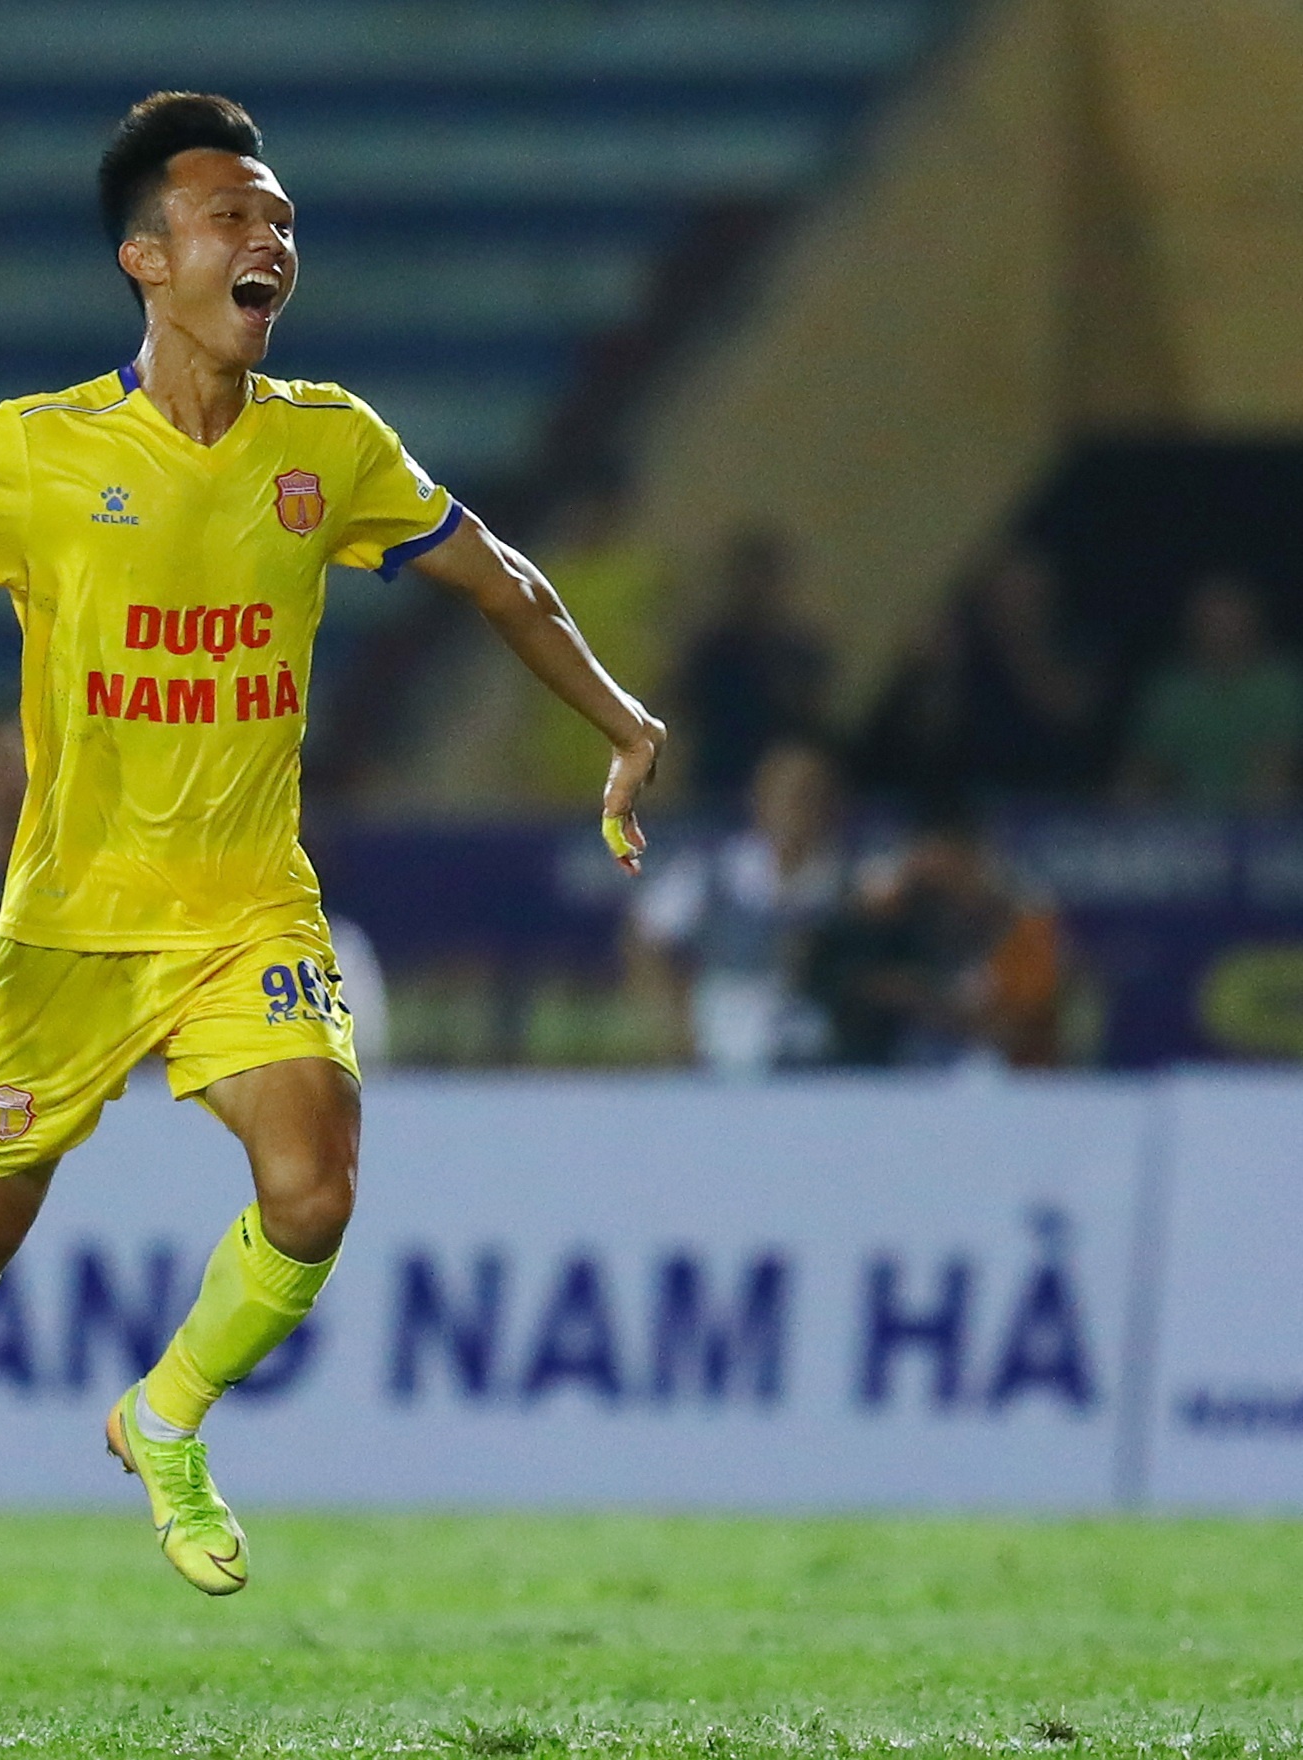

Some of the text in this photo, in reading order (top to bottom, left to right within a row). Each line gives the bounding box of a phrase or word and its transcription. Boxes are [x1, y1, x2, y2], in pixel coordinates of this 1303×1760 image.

[91, 513, 139, 525] KELME
[125, 603, 273, 662] DƯỢC
[87, 660, 300, 724] NAM HÀ
[266, 1009, 341, 1028] KEL
[386, 1240, 790, 1408] NAM
